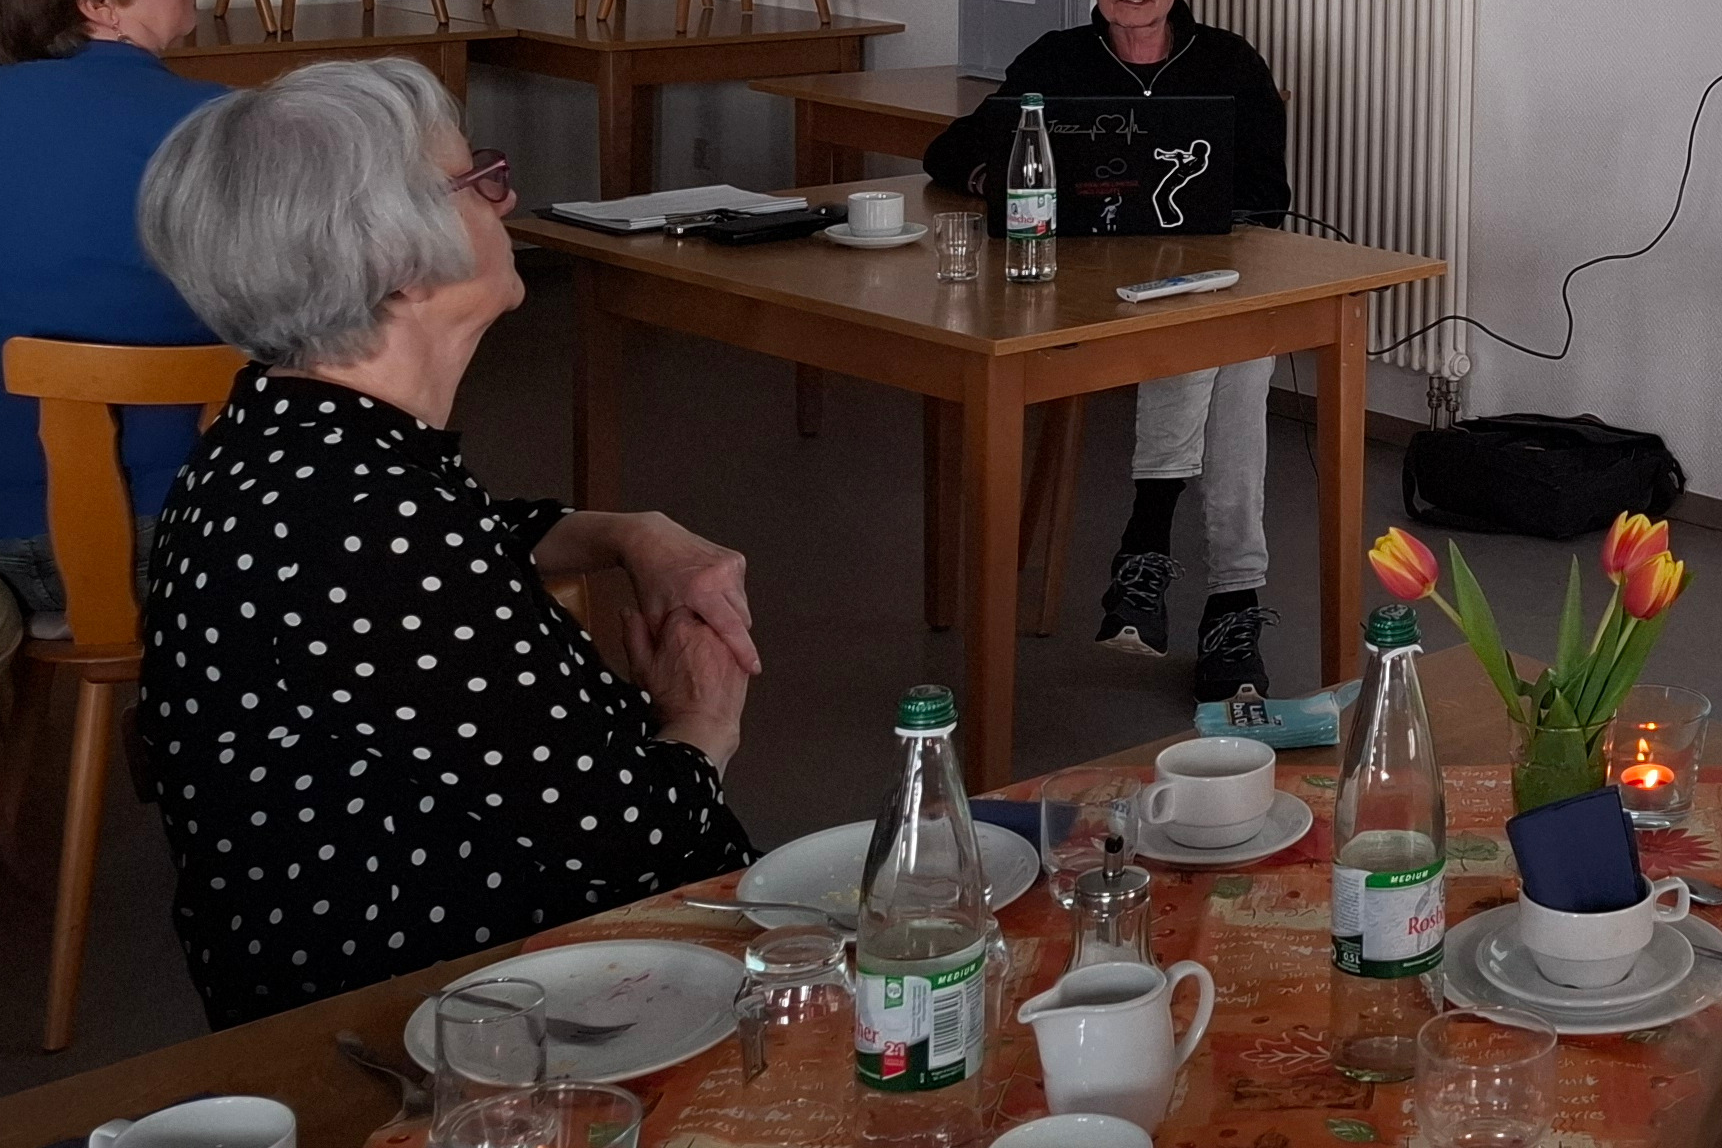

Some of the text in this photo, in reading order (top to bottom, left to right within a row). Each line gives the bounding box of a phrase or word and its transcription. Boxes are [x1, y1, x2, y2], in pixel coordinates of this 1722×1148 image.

[1048, 120, 1080, 133] Jazz
[1391, 870, 1429, 883] MEDIUM
[937, 963, 977, 984] MEDIUM
[856, 1013, 879, 1044] her
